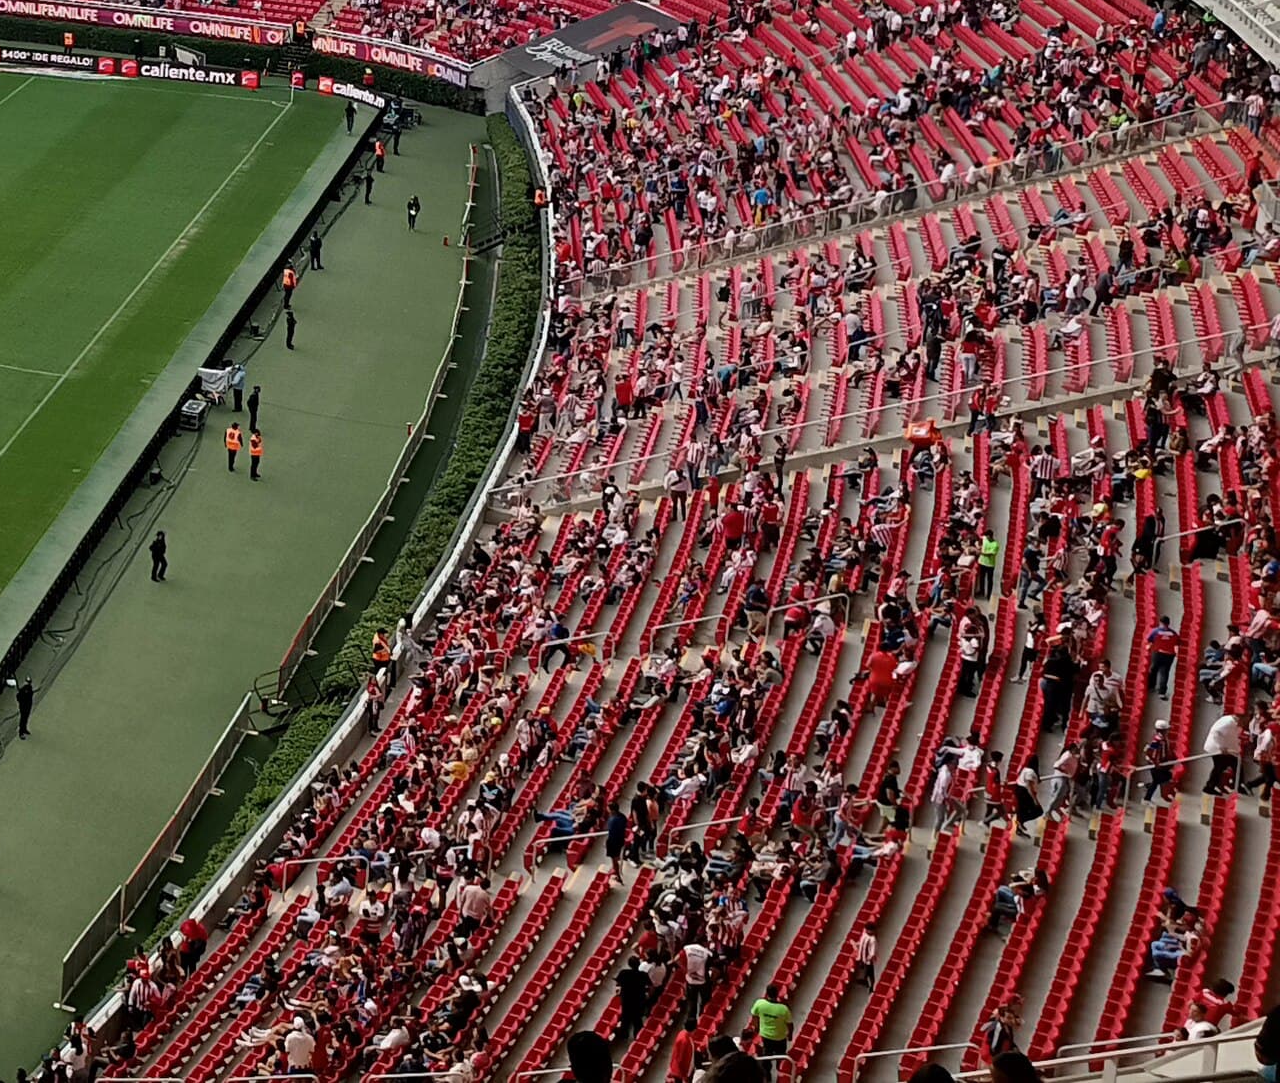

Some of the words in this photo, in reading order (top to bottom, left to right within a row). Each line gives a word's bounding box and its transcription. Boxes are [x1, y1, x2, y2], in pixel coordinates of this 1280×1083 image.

[113, 12, 174, 31] OMNILIFE
[190, 21, 251, 40] OMNILIFE
[50, 54, 94, 67] REGALO!
[371, 47, 423, 72] OMNILIFE
[140, 63, 236, 85] caliente.mx
